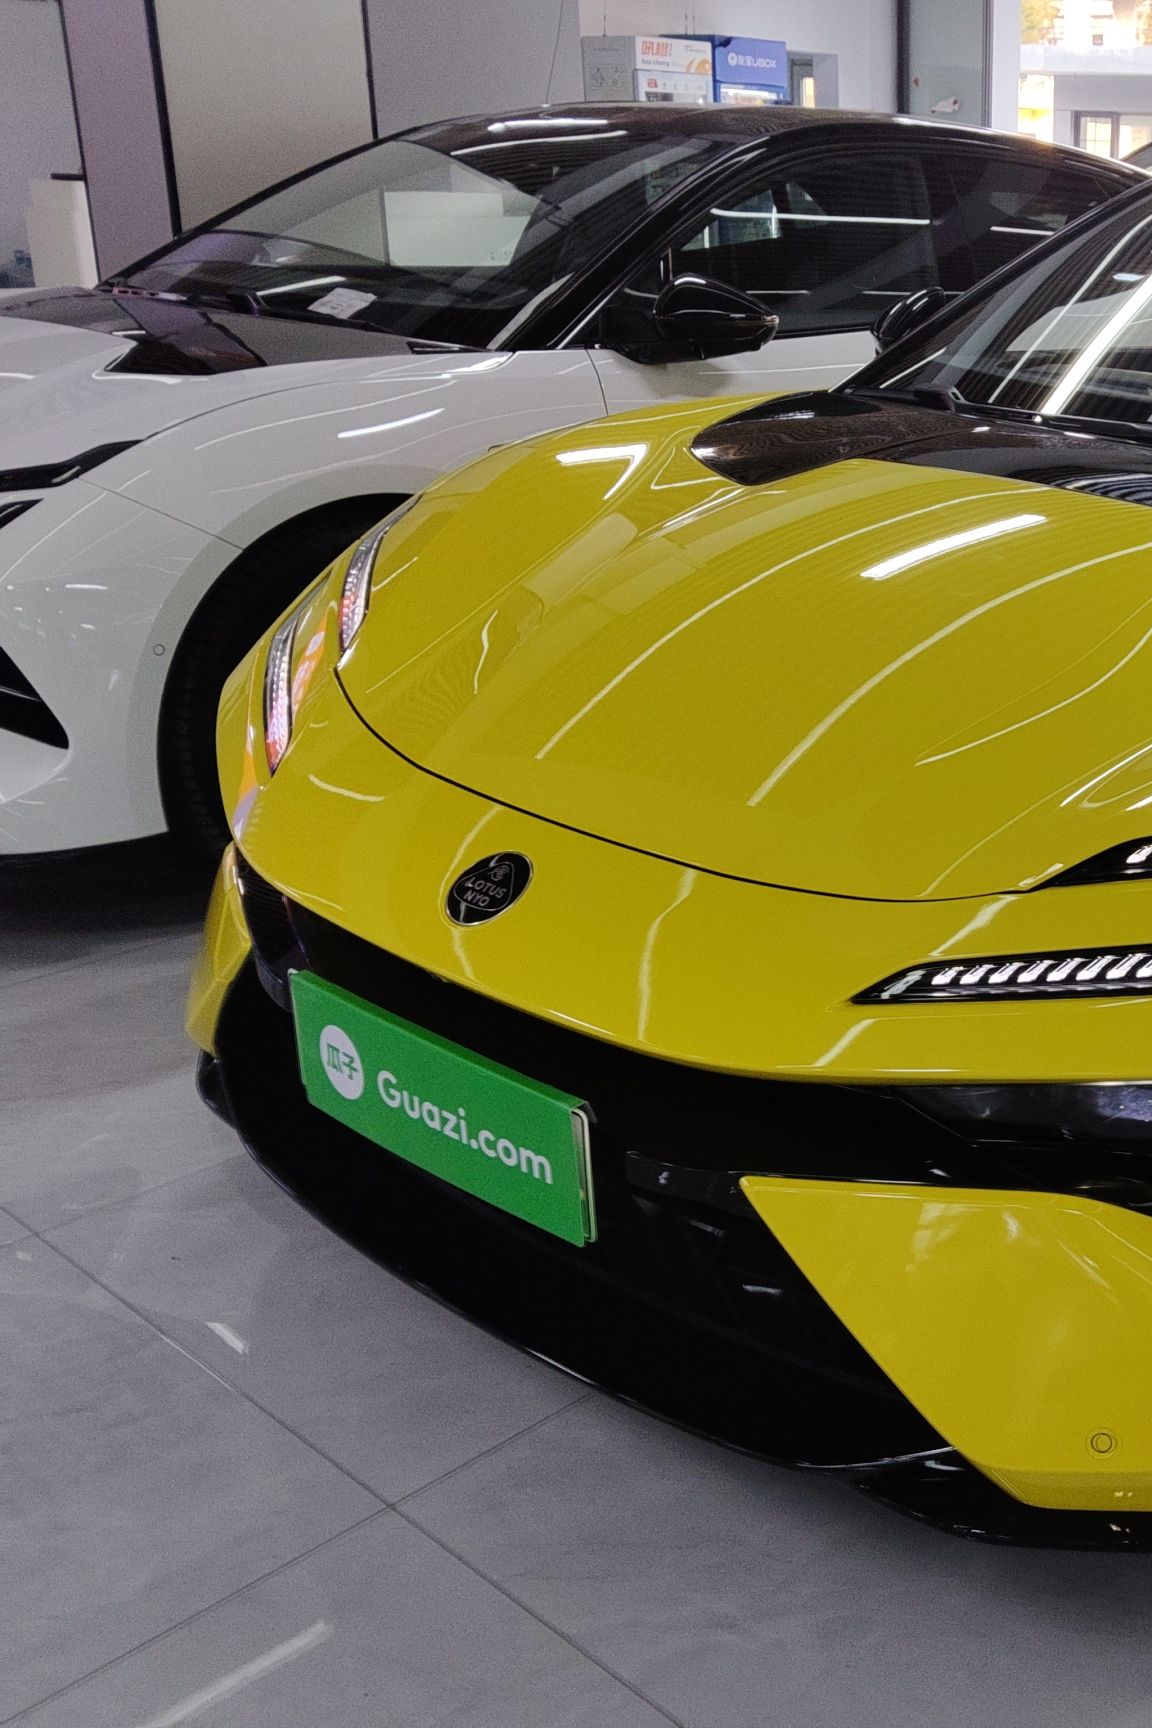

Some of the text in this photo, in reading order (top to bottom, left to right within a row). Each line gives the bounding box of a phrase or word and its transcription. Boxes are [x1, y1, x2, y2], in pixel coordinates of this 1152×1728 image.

[464, 890, 489, 906] NYO
[465, 877, 506, 898] LOTUS
[326, 1043, 358, 1080] 瓜子
[377, 1070, 553, 1184] Guazi.com
